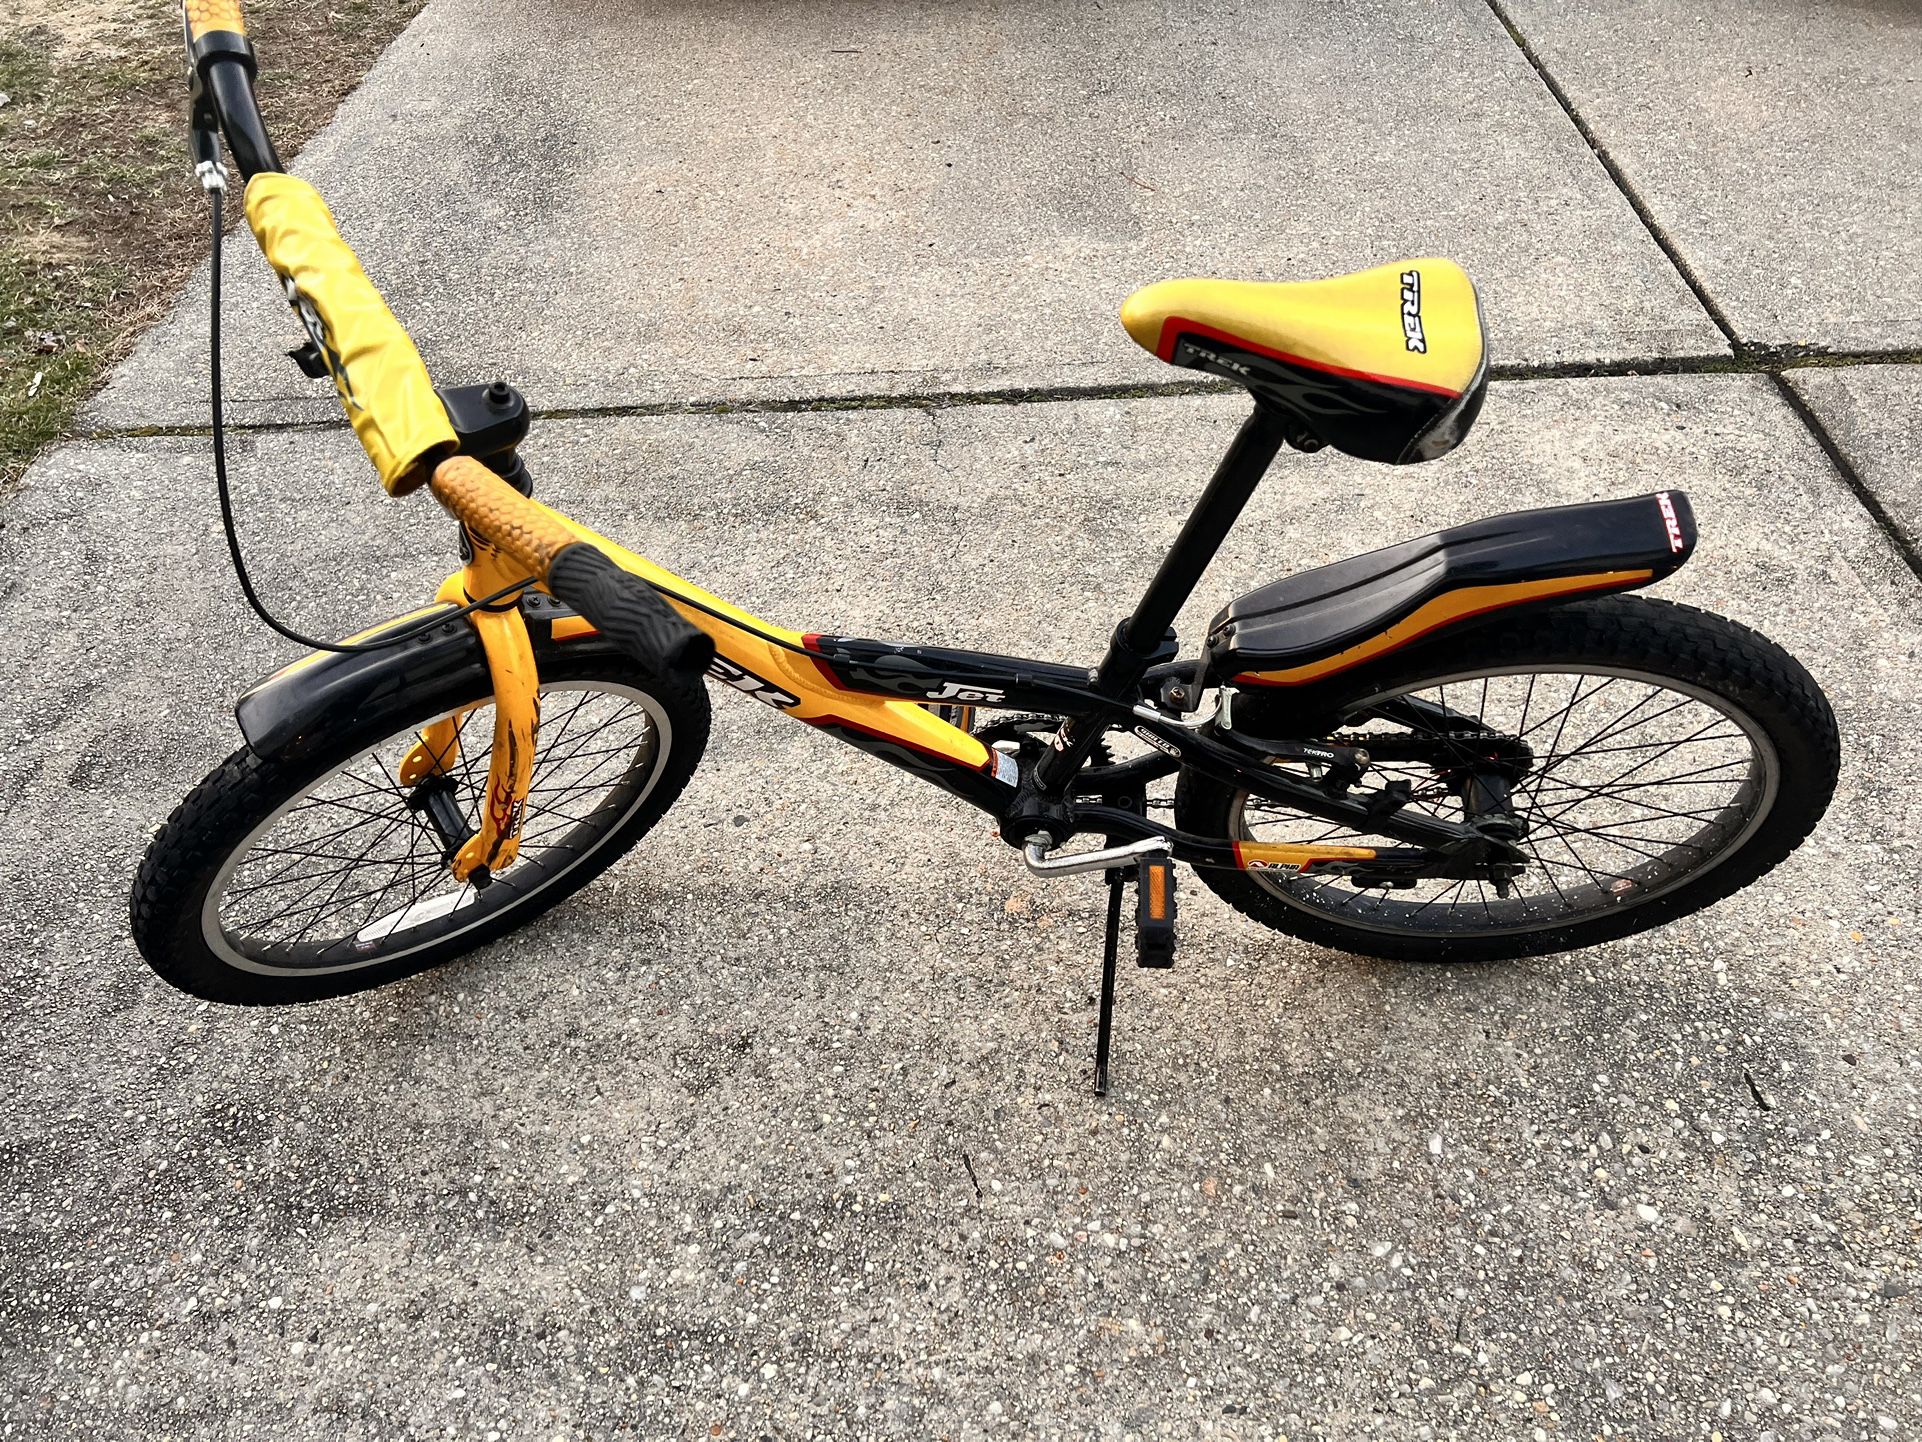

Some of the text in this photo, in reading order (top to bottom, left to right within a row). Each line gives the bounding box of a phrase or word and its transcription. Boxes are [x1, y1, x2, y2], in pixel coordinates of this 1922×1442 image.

[1400, 270, 1427, 354] TREK
[1183, 343, 1251, 376] TREK
[1655, 492, 1684, 553] TREK
[707, 656, 796, 707] EK
[926, 681, 1006, 703] Jet
